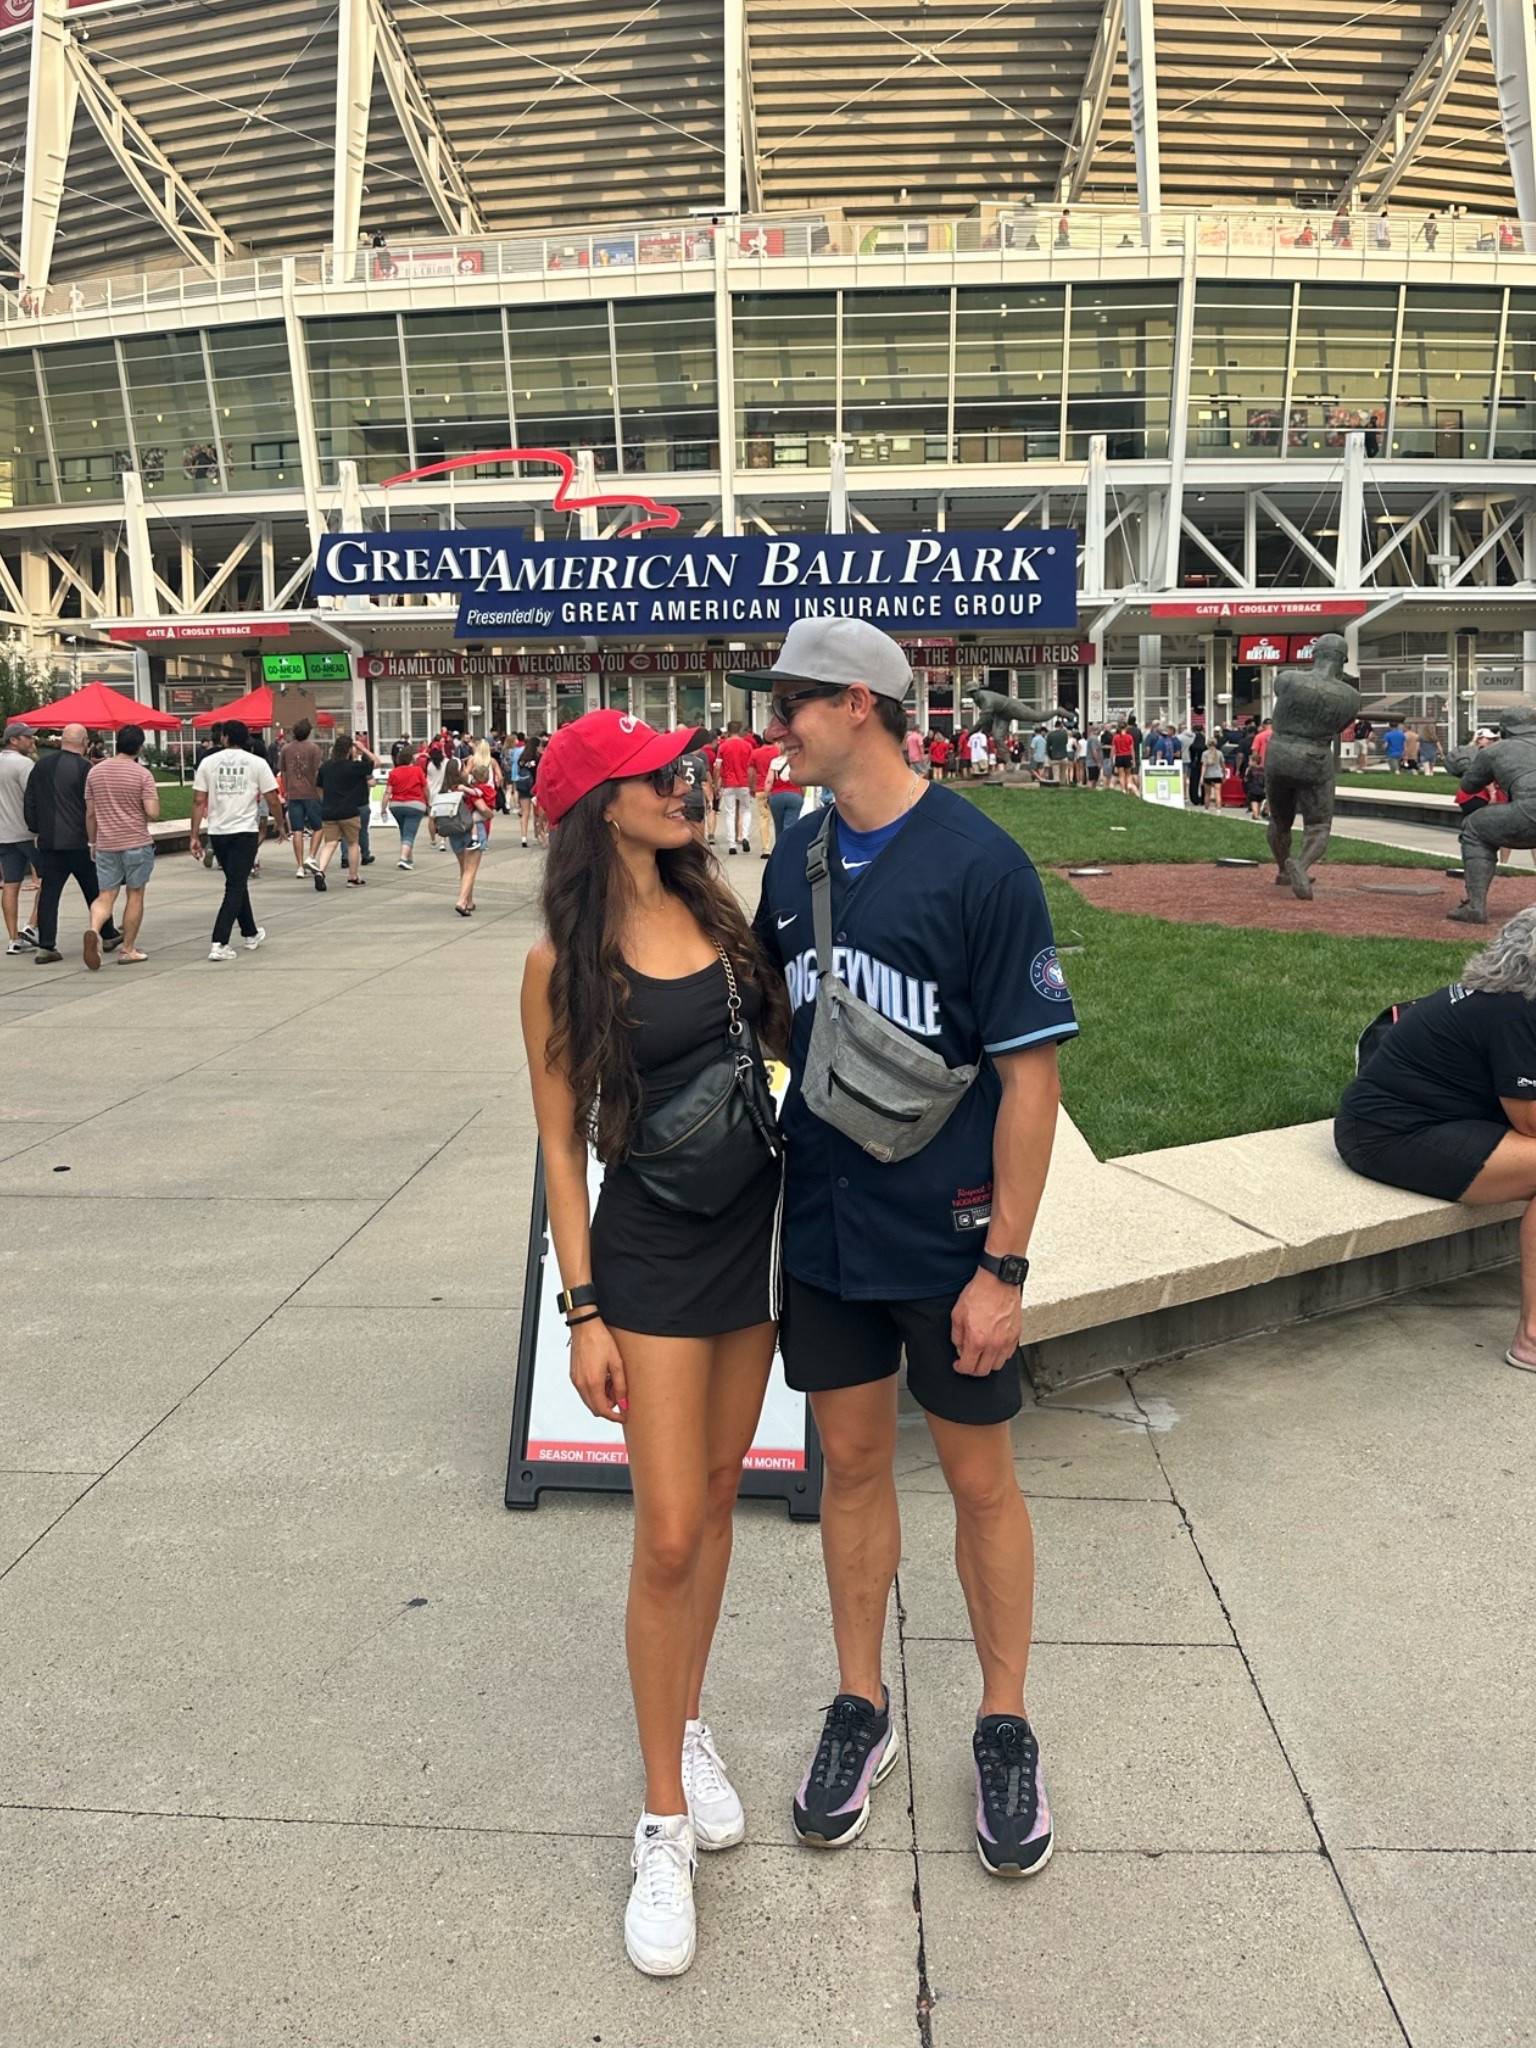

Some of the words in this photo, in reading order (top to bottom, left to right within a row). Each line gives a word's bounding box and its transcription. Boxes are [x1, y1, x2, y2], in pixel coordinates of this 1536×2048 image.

[325, 540, 493, 585] GREAT
[474, 547, 738, 593] AMERICAN
[758, 541, 891, 587] BALL
[466, 608, 534, 626] Presented
[534, 607, 555, 627] by
[561, 601, 640, 624] GREAT
[650, 598, 781, 623] AMERICAN
[794, 594, 942, 618] INSURANCE
[954, 593, 1043, 616] GROUP
[1196, 605, 1219, 614] GATE
[1220, 603, 1231, 616] A
[1238, 605, 1278, 614] CROSLEY
[1280, 603, 1321, 613] TERRACE
[146, 629, 166, 638] GATE
[166, 627, 176, 639] A
[181, 627, 215, 637] CROSLEY
[216, 626, 251, 635] TERRACE
[388, 657, 456, 676] HAMILTON
[460, 655, 513, 675] COUNTY
[517, 654, 592, 674] WELCOMES
[598, 653, 626, 672] YOU
[654, 652, 679, 671] 100
[683, 652, 707, 671] JOE
[923, 647, 949, 665] THE
[955, 645, 1037, 665] CINCINNATI
[1042, 644, 1080, 663] REDS
[1429, 676, 1444, 686] ICE
[1483, 676, 1516, 686] CANDY
[784, 946, 943, 1036] RIGEYVILLE
[539, 1449, 583, 1460] SEASON
[585, 1450, 624, 1462] TICKET
[755, 1457, 796, 1469] MONTH
